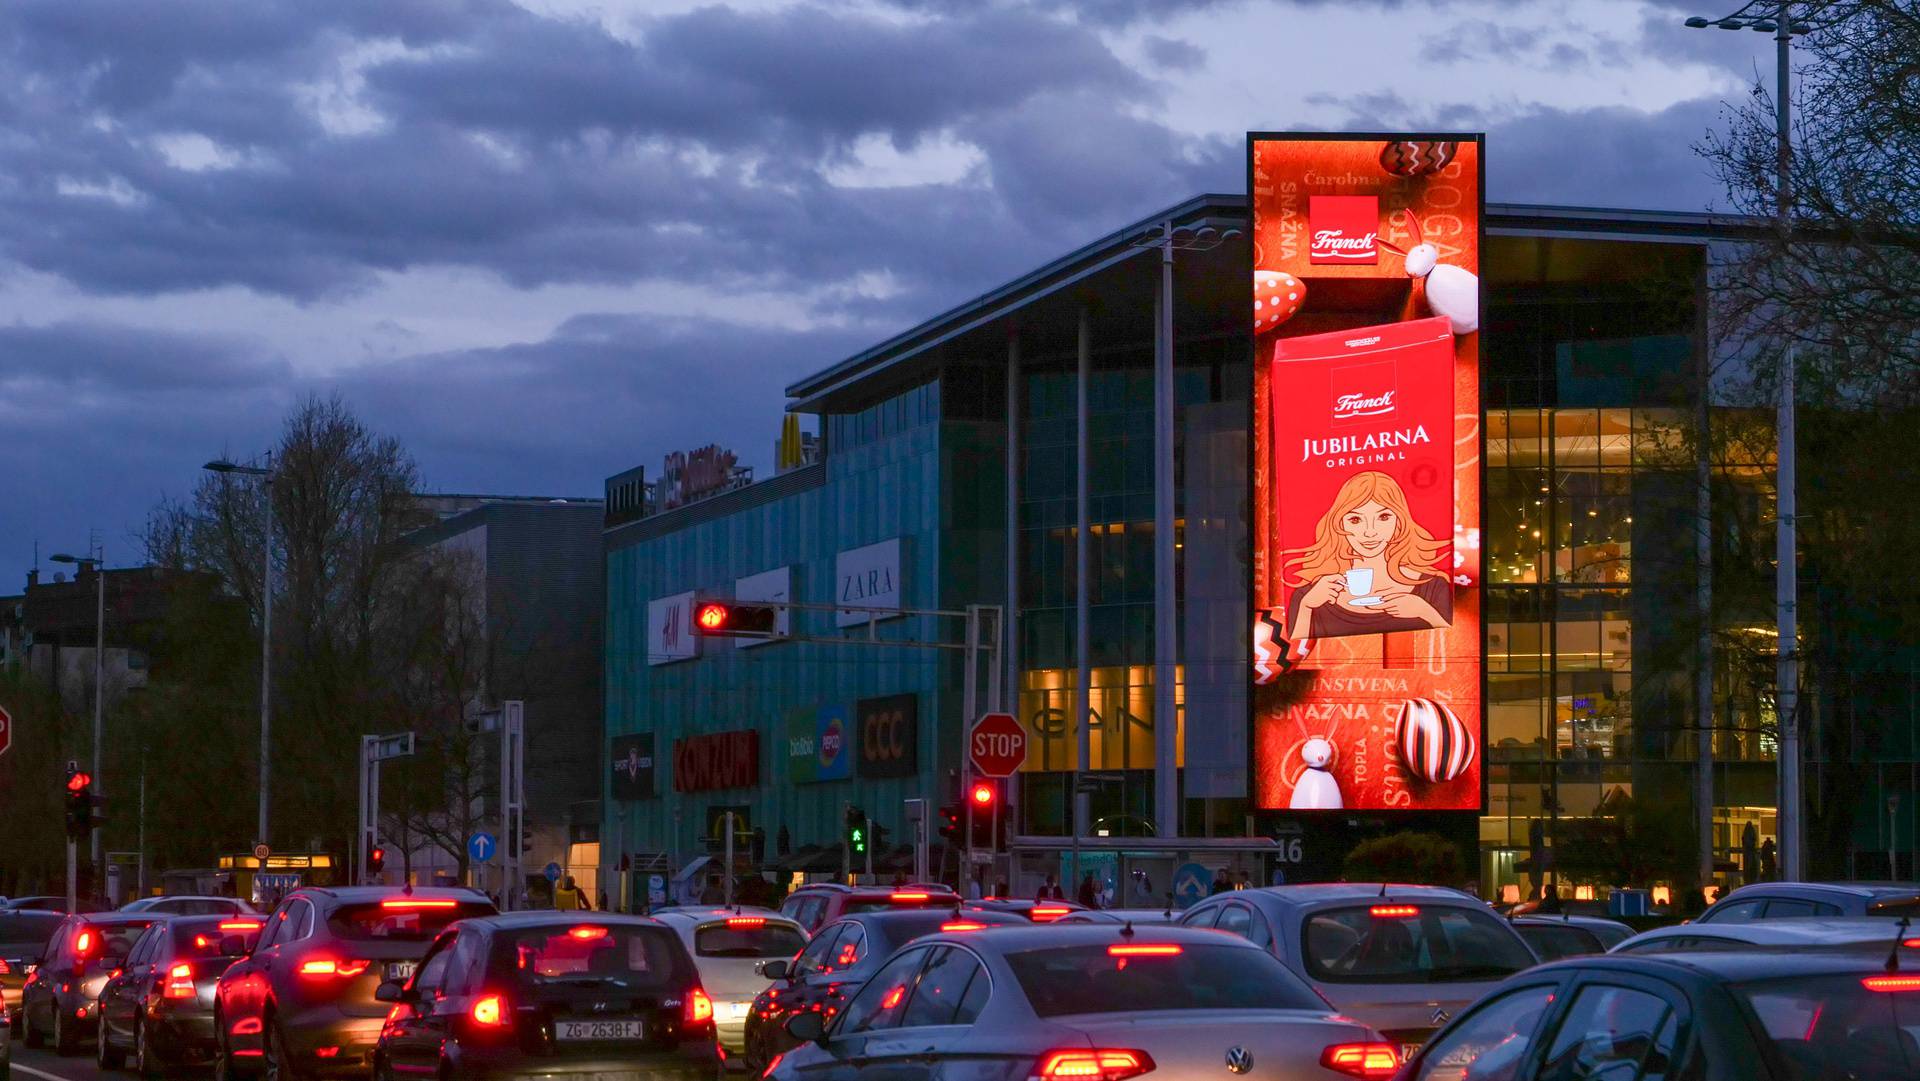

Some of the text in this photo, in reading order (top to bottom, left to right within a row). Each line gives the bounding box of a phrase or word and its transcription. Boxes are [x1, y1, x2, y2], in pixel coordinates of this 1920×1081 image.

[1281, 182, 1304, 260] SNAŽNA
[1311, 229, 1376, 251] Franck
[1334, 391, 1395, 412] Franck
[1302, 425, 1430, 462] JUBILARNA
[1326, 451, 1405, 468] ORIGINAL
[842, 567, 892, 602] ZARA
[864, 711, 904, 761] CCC
[975, 732, 1022, 757] STOP
[1355, 738, 1367, 784] TOPLA
[1275, 838, 1303, 862] 16
[566, 1023, 582, 1038] ZG
